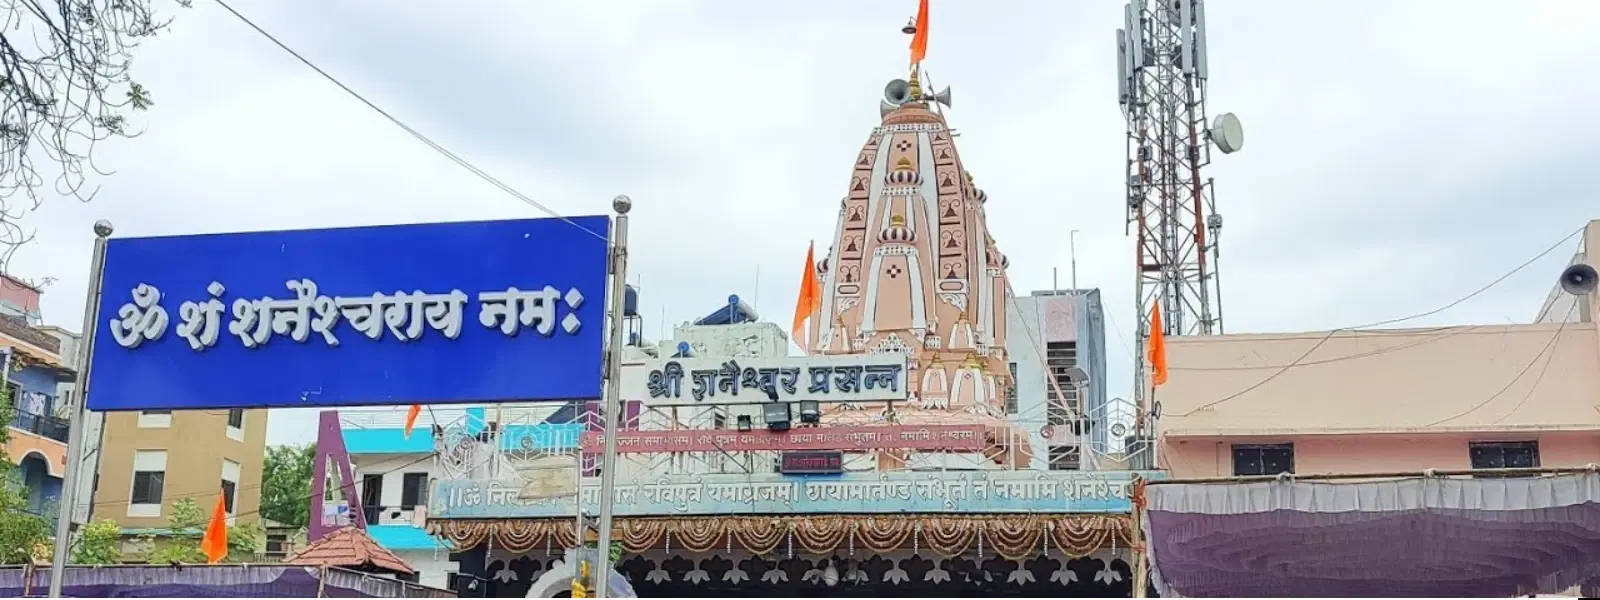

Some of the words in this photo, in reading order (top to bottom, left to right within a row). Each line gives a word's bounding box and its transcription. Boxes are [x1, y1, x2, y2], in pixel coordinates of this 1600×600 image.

[110, 283, 169, 349] ॐ
[176, 281, 226, 350] शं
[229, 279, 469, 350] शनैश्चराय
[478, 284, 585, 337] नमः
[647, 360, 685, 398] श्री
[808, 364, 902, 394] प्रसन्न
